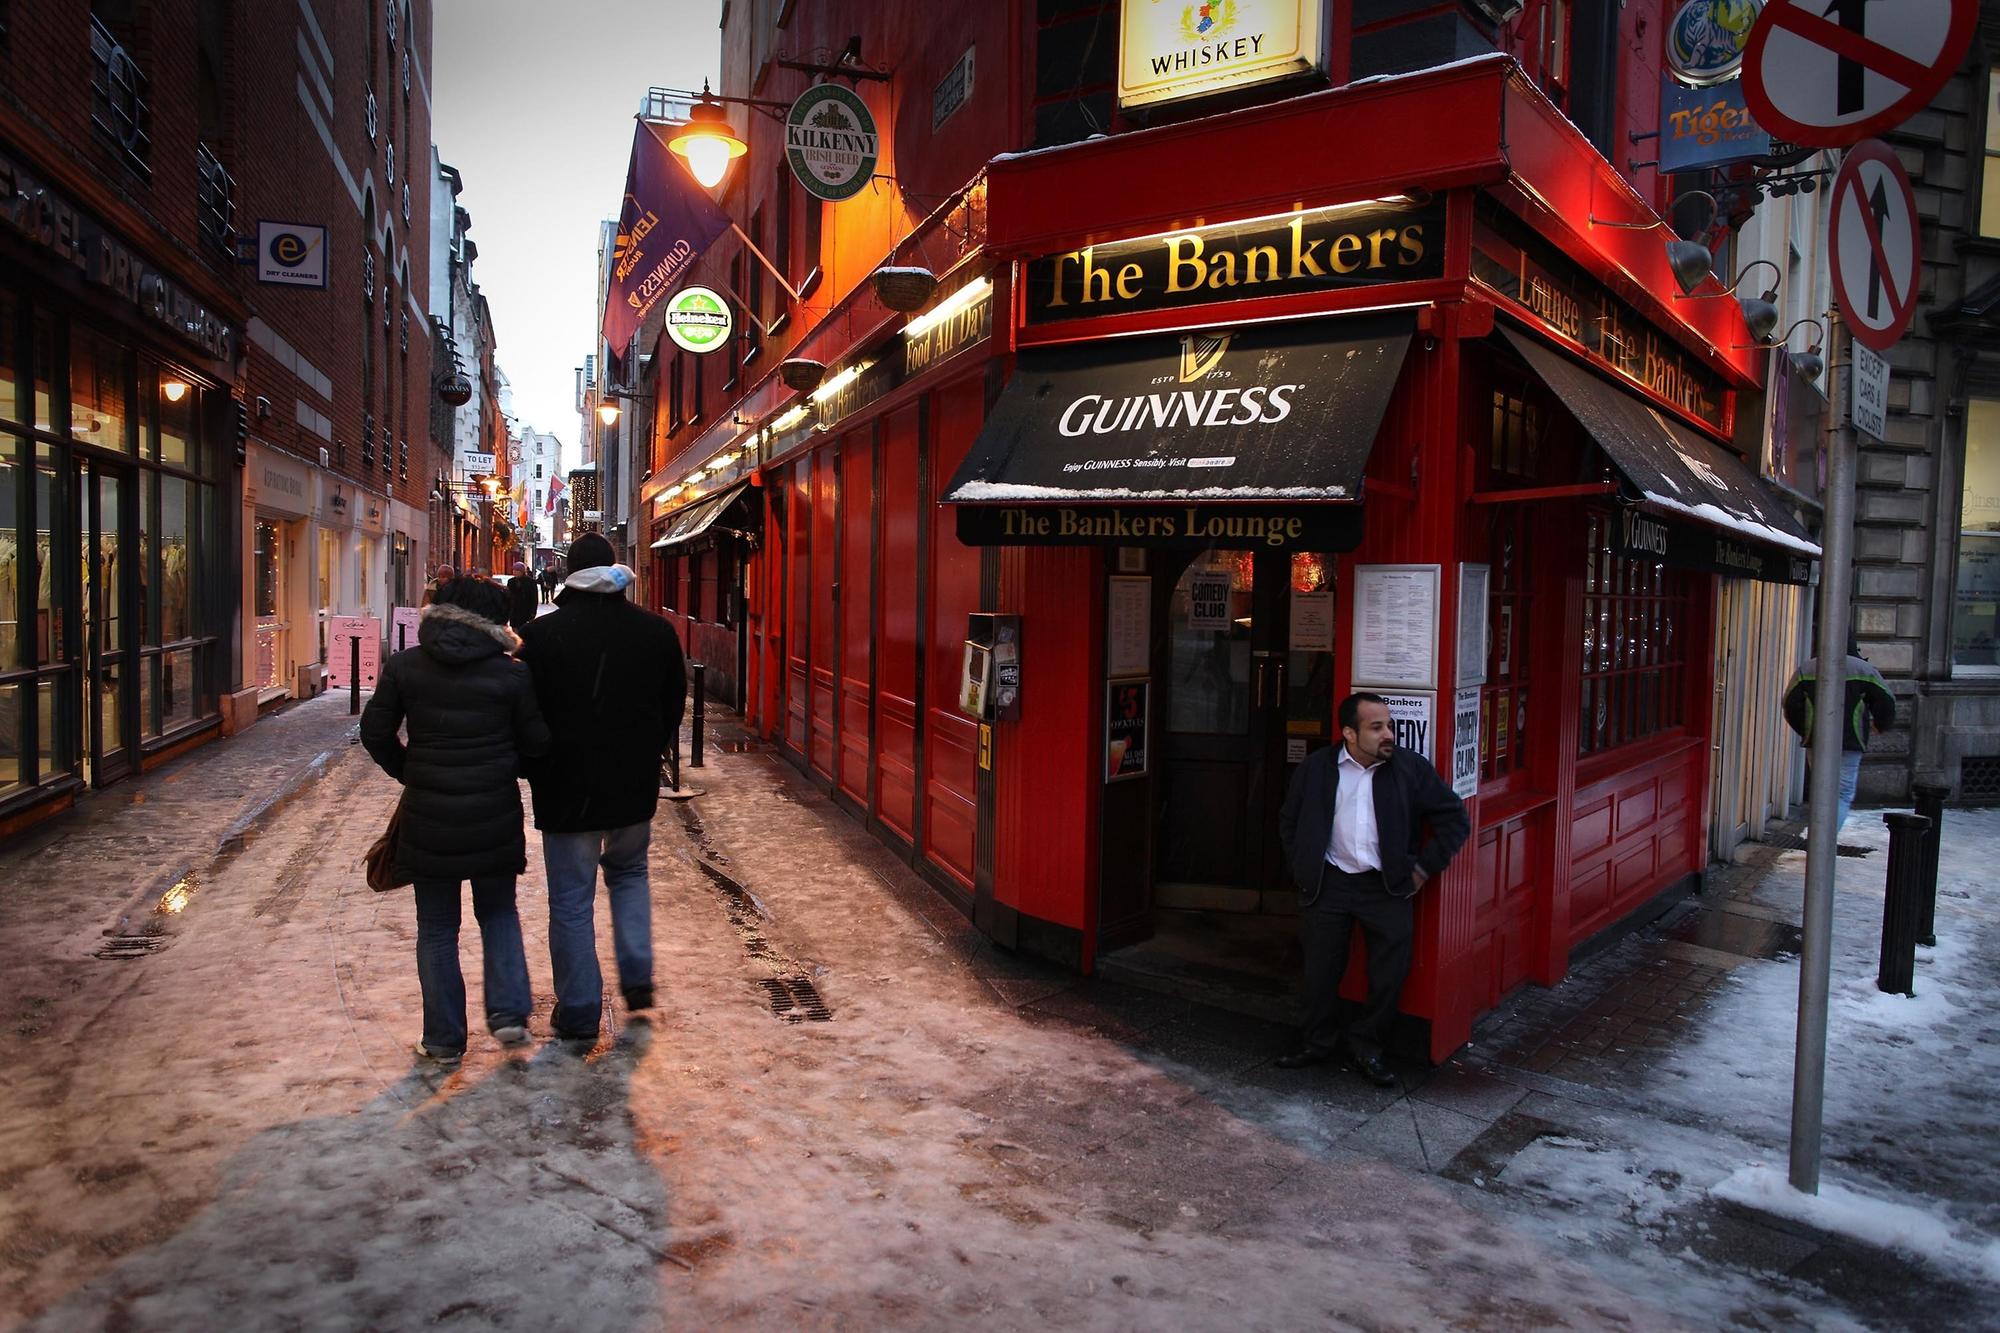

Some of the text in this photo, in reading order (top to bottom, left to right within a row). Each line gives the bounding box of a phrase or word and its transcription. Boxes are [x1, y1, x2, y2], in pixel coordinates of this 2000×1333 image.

[1152, 33, 1264, 75] WHISKEY
[787, 125, 877, 154] KILKENNY
[805, 149, 859, 166] IRISH BEER
[282, 271, 318, 280] CLEANERS
[1045, 216, 1424, 308] The Bankers
[670, 311, 727, 326] Heineken
[1519, 249, 1706, 418] Lounge The Bankers
[905, 302, 988, 376] Food All Day
[1206, 370, 1232, 380] 1759
[1861, 349, 1883, 384] EXCEPT
[1058, 384, 1297, 437] GUINNESS
[468, 455, 492, 464] TO LET
[1063, 463, 1083, 472] Enjoy
[1083, 458, 1132, 471] GUINNESS
[1168, 458, 1186, 467] Visit
[1000, 507, 1303, 546] The Bankers Lounge
[1632, 512, 1669, 556] GUINNESS
[1192, 583, 1229, 601] COMEDY
[1195, 603, 1225, 617] CLUB
[1383, 697, 1422, 706] Bankers
[1456, 710, 1479, 748] COMEDY
[980, 731, 990, 766] H
[1456, 746, 1475, 780] CLUB
